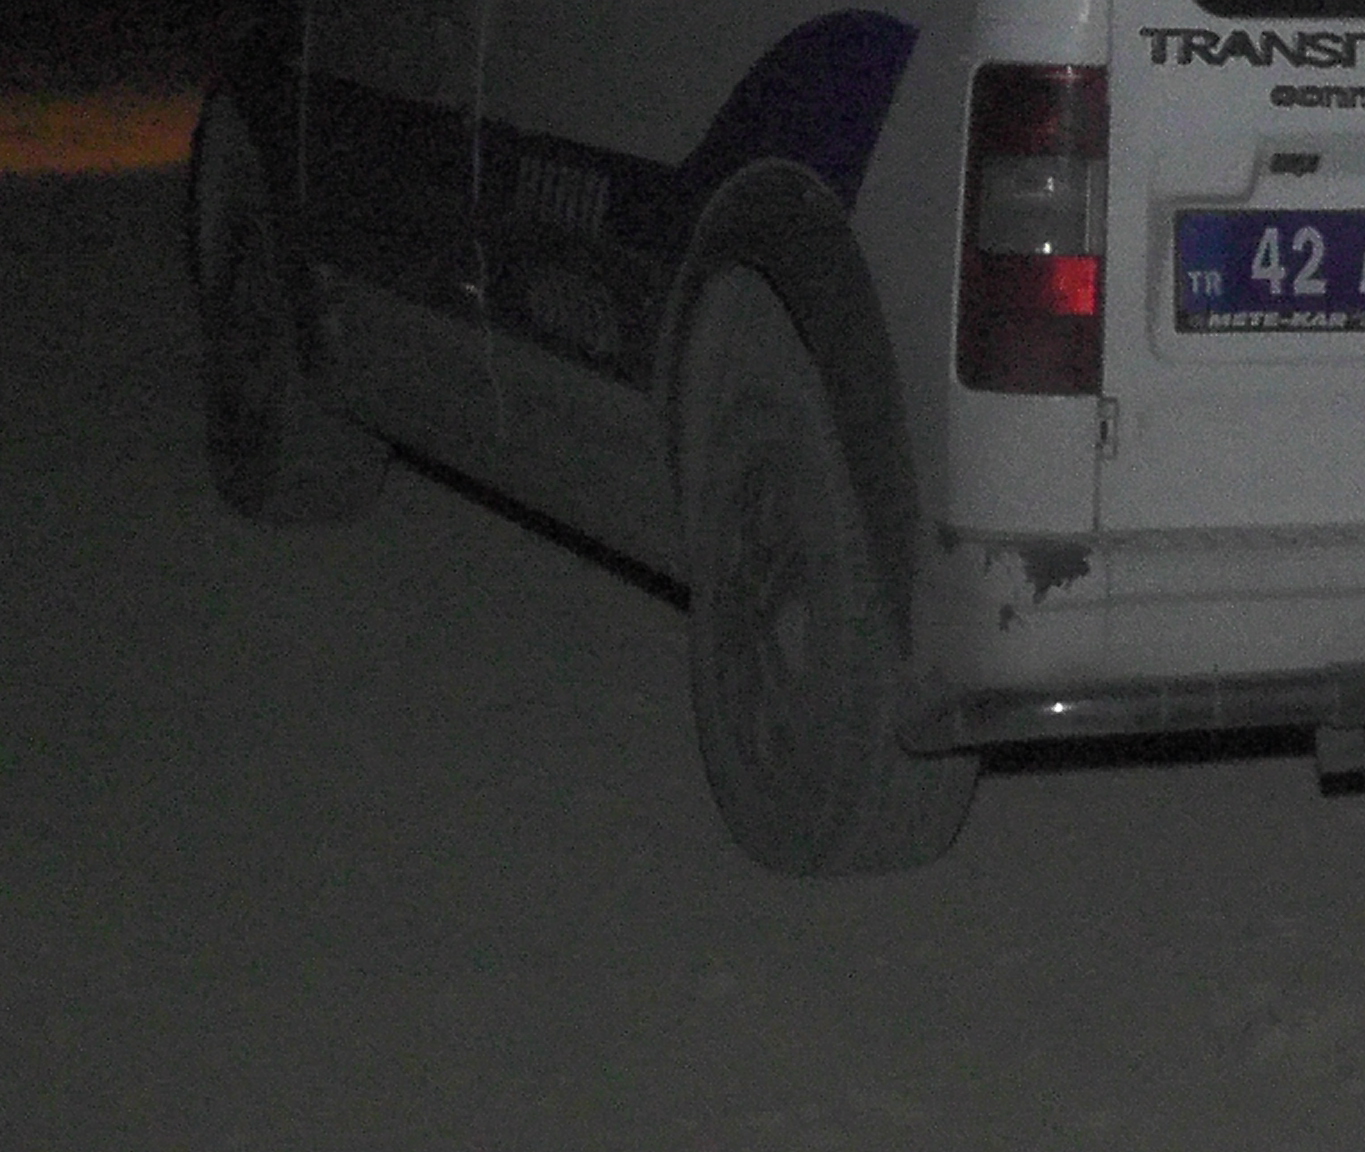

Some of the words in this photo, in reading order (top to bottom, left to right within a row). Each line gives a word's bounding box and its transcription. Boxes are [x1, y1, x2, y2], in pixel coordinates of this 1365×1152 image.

[1250, 226, 1327, 295] 42
[1187, 269, 1224, 297] TR
[1207, 310, 1349, 329] METE-KAR
